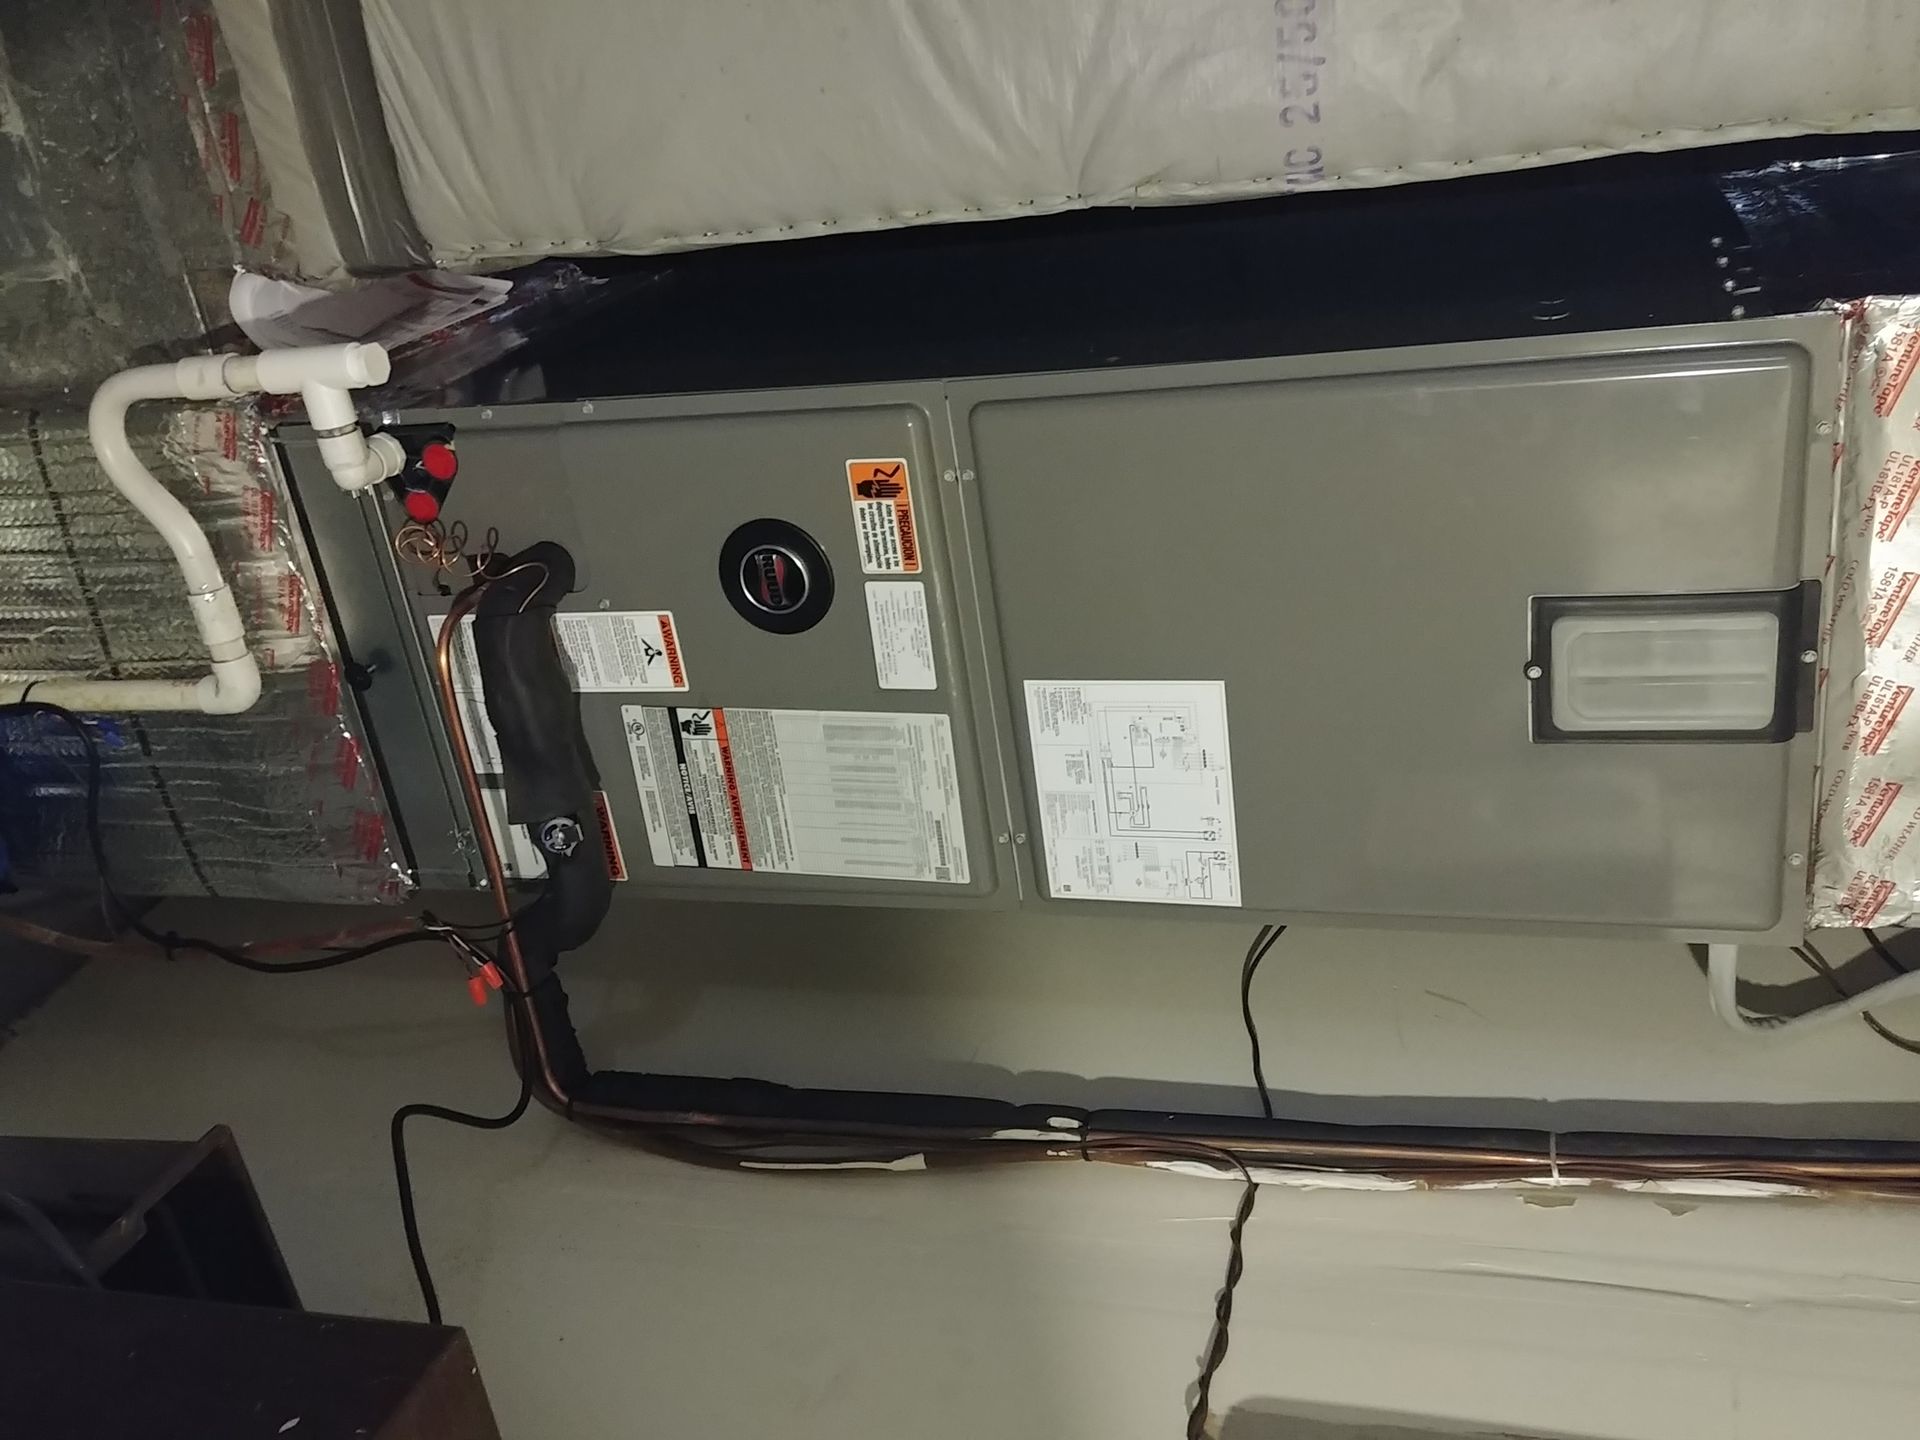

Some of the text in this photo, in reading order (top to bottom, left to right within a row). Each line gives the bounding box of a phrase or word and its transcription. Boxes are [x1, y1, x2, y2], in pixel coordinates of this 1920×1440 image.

[1861, 450, 1900, 512] UL181B-FX
[1880, 454, 1913, 509] UL181A-P
[762, 554, 784, 606] RUUD
[1871, 566, 1898, 600] 1581A
[663, 630, 683, 683] WARNING
[1847, 675, 1883, 727] UL181B-FX
[1860, 684, 1908, 754] VentureTape
[1864, 680, 1895, 727] UL181A-P
[679, 763, 696, 815] NOTICE/AVIS
[1849, 782, 1899, 846] VentureTape
[1856, 777, 1881, 807] 1581A
